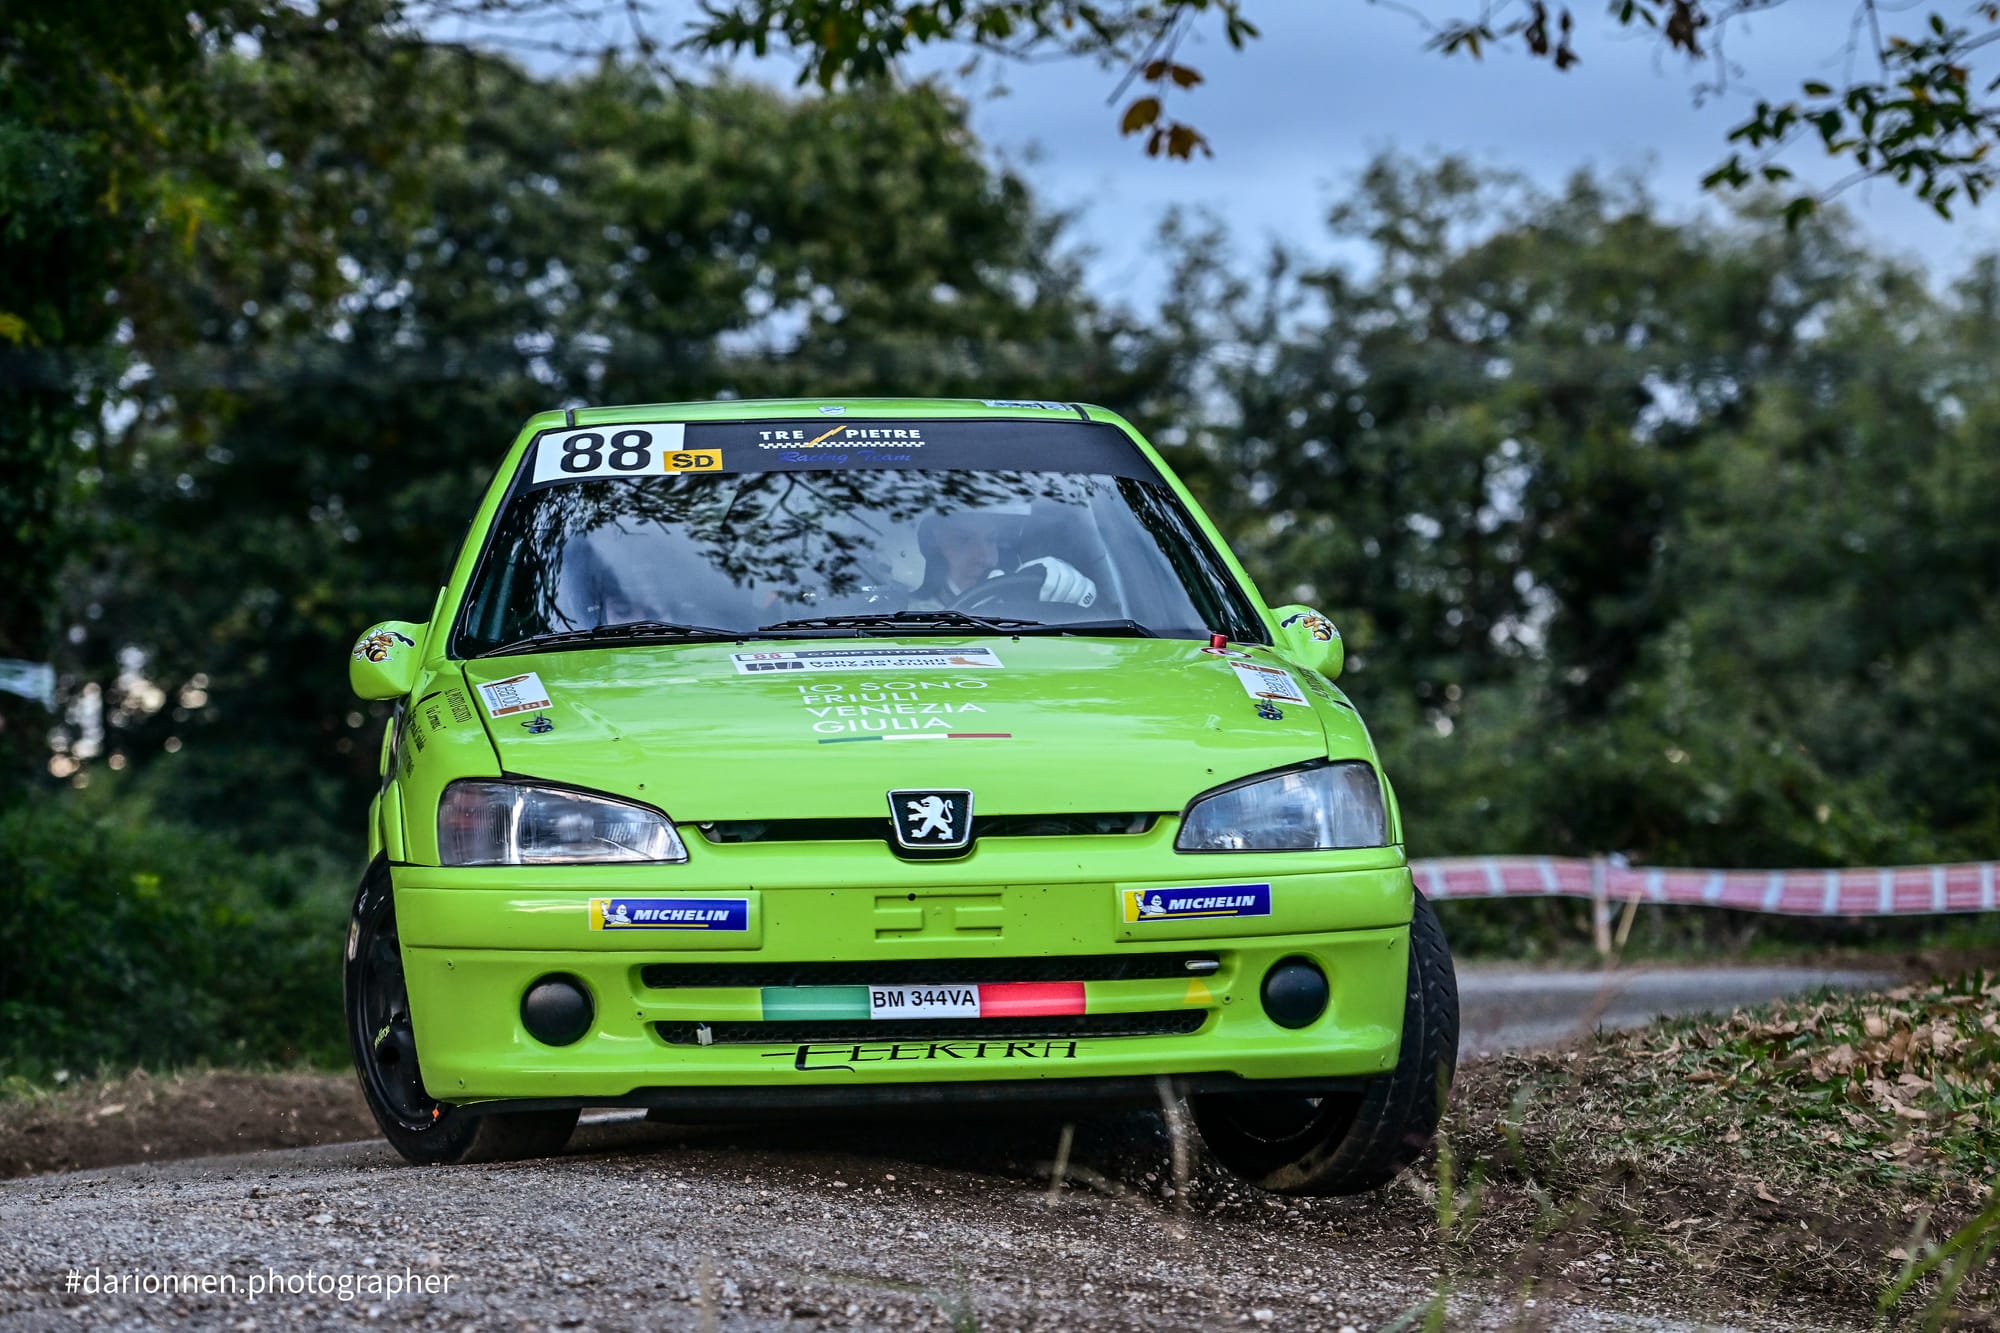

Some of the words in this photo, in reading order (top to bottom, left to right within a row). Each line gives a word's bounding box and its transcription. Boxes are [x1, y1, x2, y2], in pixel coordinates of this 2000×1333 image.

[759, 430, 804, 441] TRE
[845, 429, 921, 439] PIETRE
[560, 429, 654, 473] 88
[778, 451, 849, 464] Racing
[857, 450, 911, 462] Team
[672, 453, 715, 469] SD
[798, 683, 843, 694] IO
[859, 680, 988, 692] SONO
[801, 691, 919, 705] FRIULI
[805, 702, 988, 718] VENEZIA
[812, 716, 953, 733] GIULIA
[1168, 895, 1256, 910] MICHELIN
[633, 909, 730, 921] MICHELIN
[872, 990, 905, 1009] BM
[911, 989, 977, 1007] 344VA
[762, 1041, 1085, 1073] ELEKTRA
